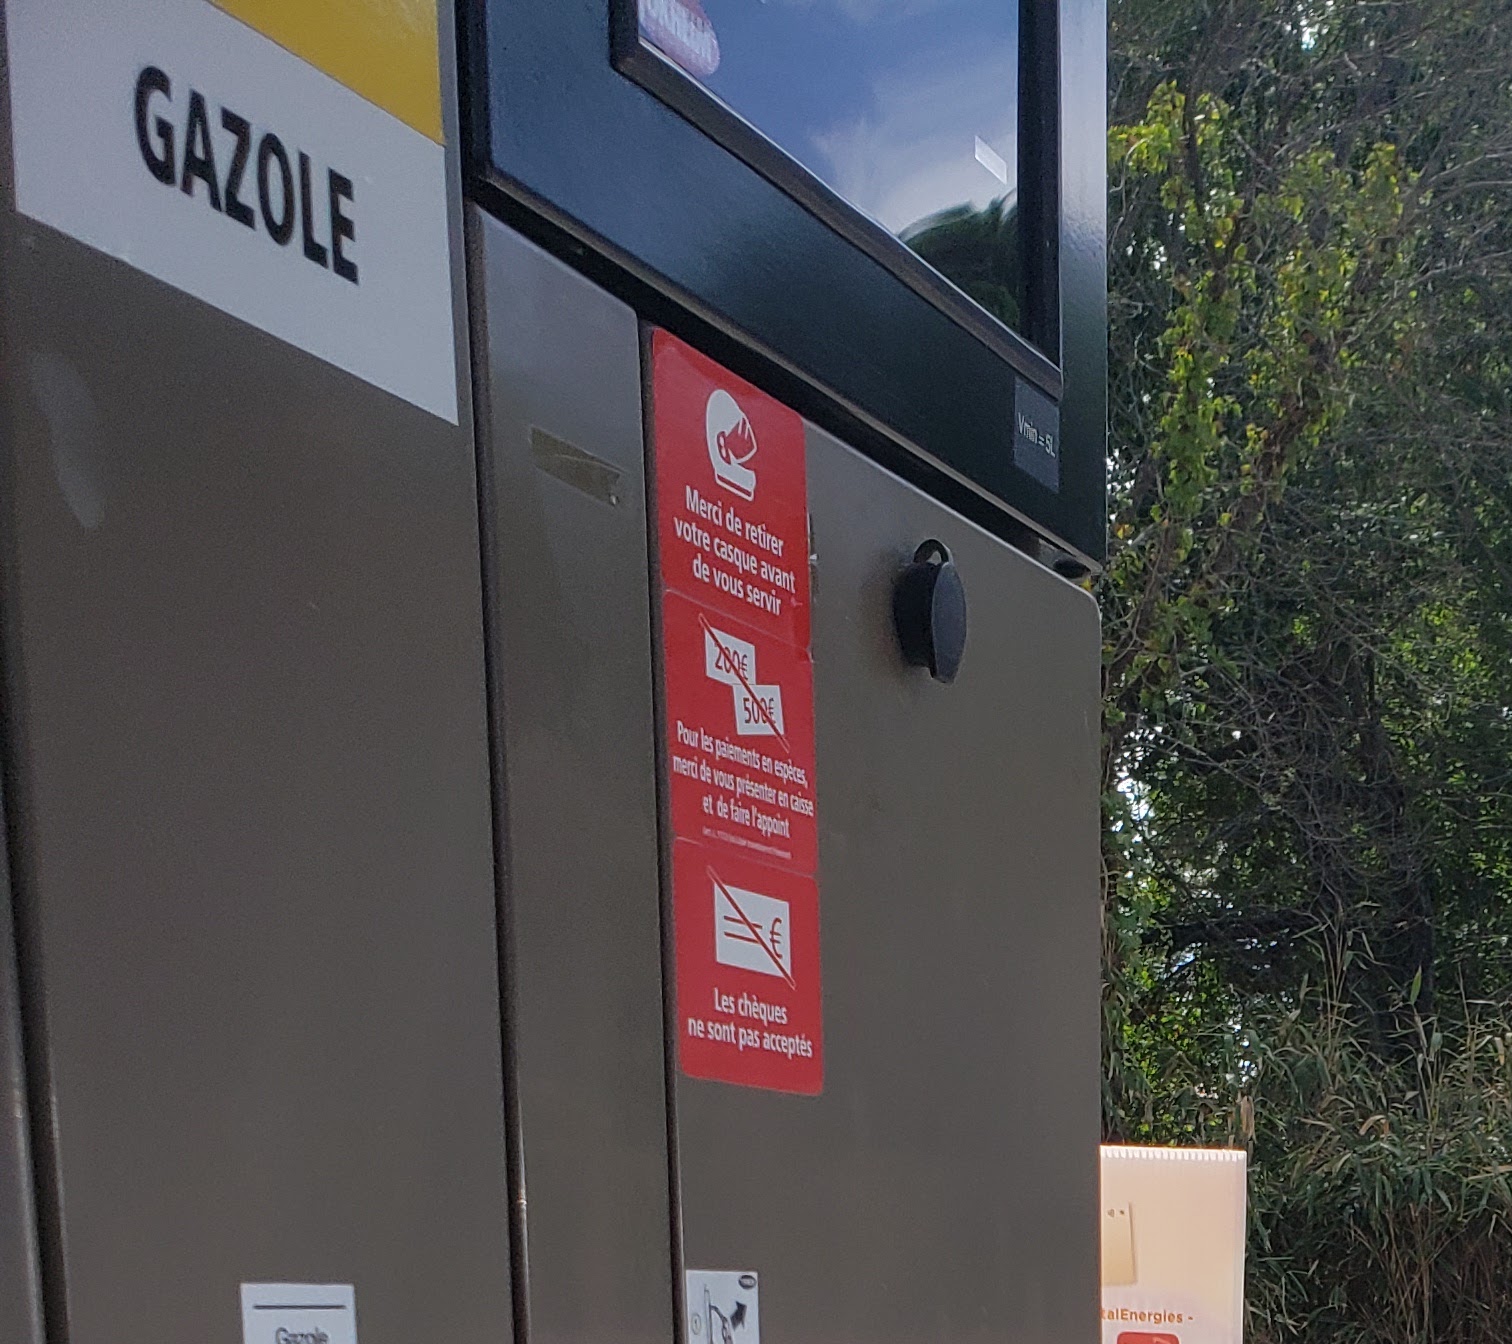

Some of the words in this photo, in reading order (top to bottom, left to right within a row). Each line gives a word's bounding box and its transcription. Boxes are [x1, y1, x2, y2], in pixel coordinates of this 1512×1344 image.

[134, 65, 360, 286] GAZOLE
[1018, 412, 1038, 444] Vmin
[1046, 434, 1056, 458] 5L
[686, 485, 723, 527] Merci
[726, 506, 742, 537] de
[745, 521, 784, 557] retirer
[673, 517, 711, 552] votre
[713, 537, 758, 575] casque
[760, 560, 796, 594] avant
[692, 553, 710, 583] de
[713, 567, 744, 599] vous
[747, 583, 782, 616] servir
[676, 720, 699, 748] Pour
[701, 727, 714, 753] les
[716, 736, 760, 770] paiements
[762, 754, 773, 774] en
[774, 759, 808, 789] espèces,
[673, 755, 698, 779] merci
[700, 760, 712, 785] de
[713, 769, 735, 791] vous
[736, 774, 776, 805] présenter
[778, 790, 789, 809] en
[790, 791, 814, 817] caisse
[702, 796, 714, 815] et
[717, 795, 729, 819] de
[729, 798, 751, 826] faire
[752, 805, 791, 838] l'appoint
[714, 987, 735, 1015] Les
[737, 993, 788, 1027] chèques
[688, 1017, 704, 1038] ne
[707, 1022, 736, 1044] sont
[738, 1028, 760, 1052] pas
[763, 1031, 813, 1060] acceptés
